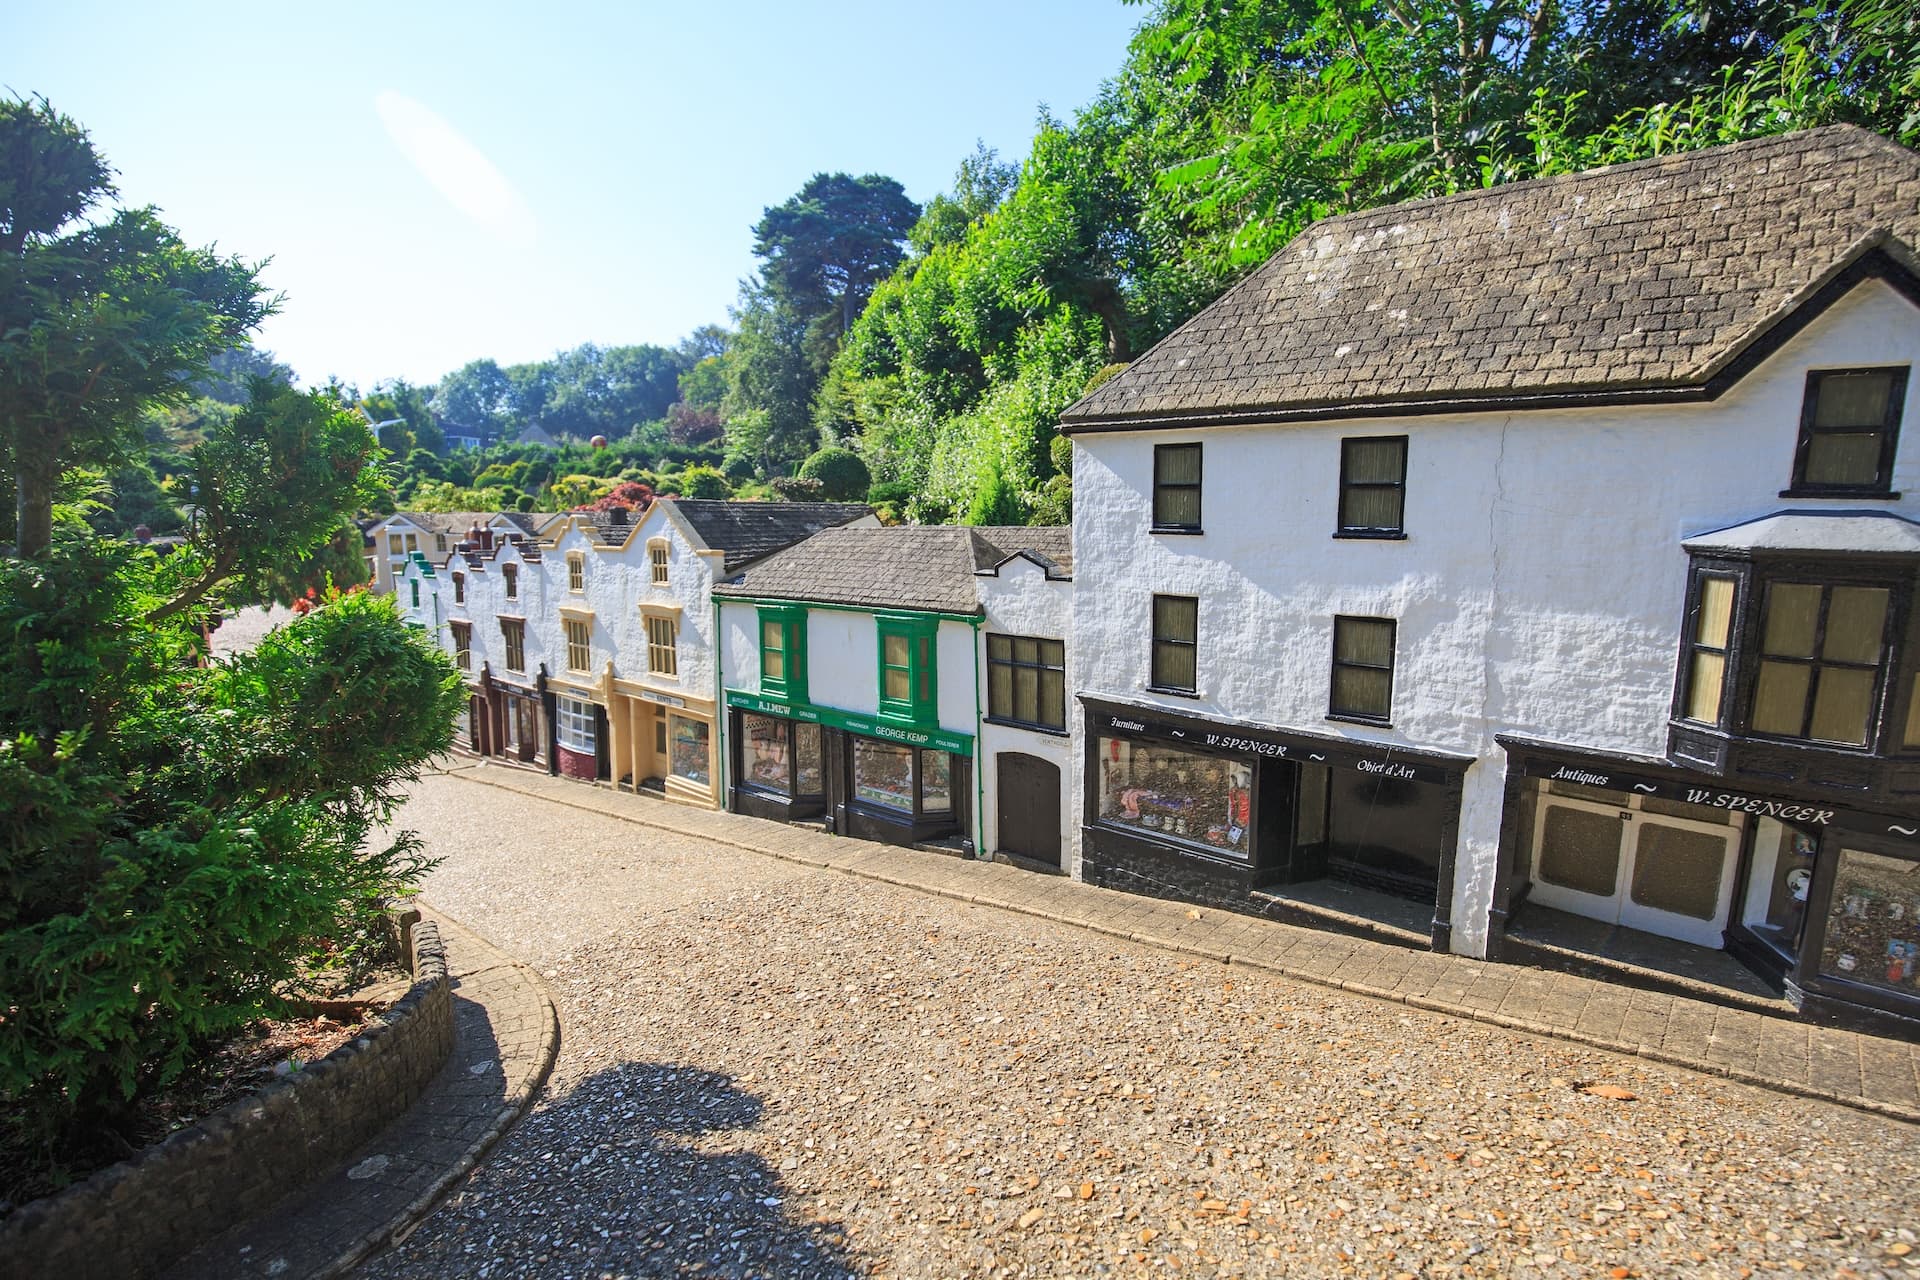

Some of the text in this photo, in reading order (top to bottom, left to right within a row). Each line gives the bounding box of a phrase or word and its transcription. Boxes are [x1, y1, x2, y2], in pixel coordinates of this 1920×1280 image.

[875, 726, 906, 740] GEORGE
[906, 732, 929, 744] KEMP
[1110, 716, 1416, 779] Furniture W.SPENCER Objet d'Art
[1550, 766, 1835, 825] Antiques W.SPENCER
